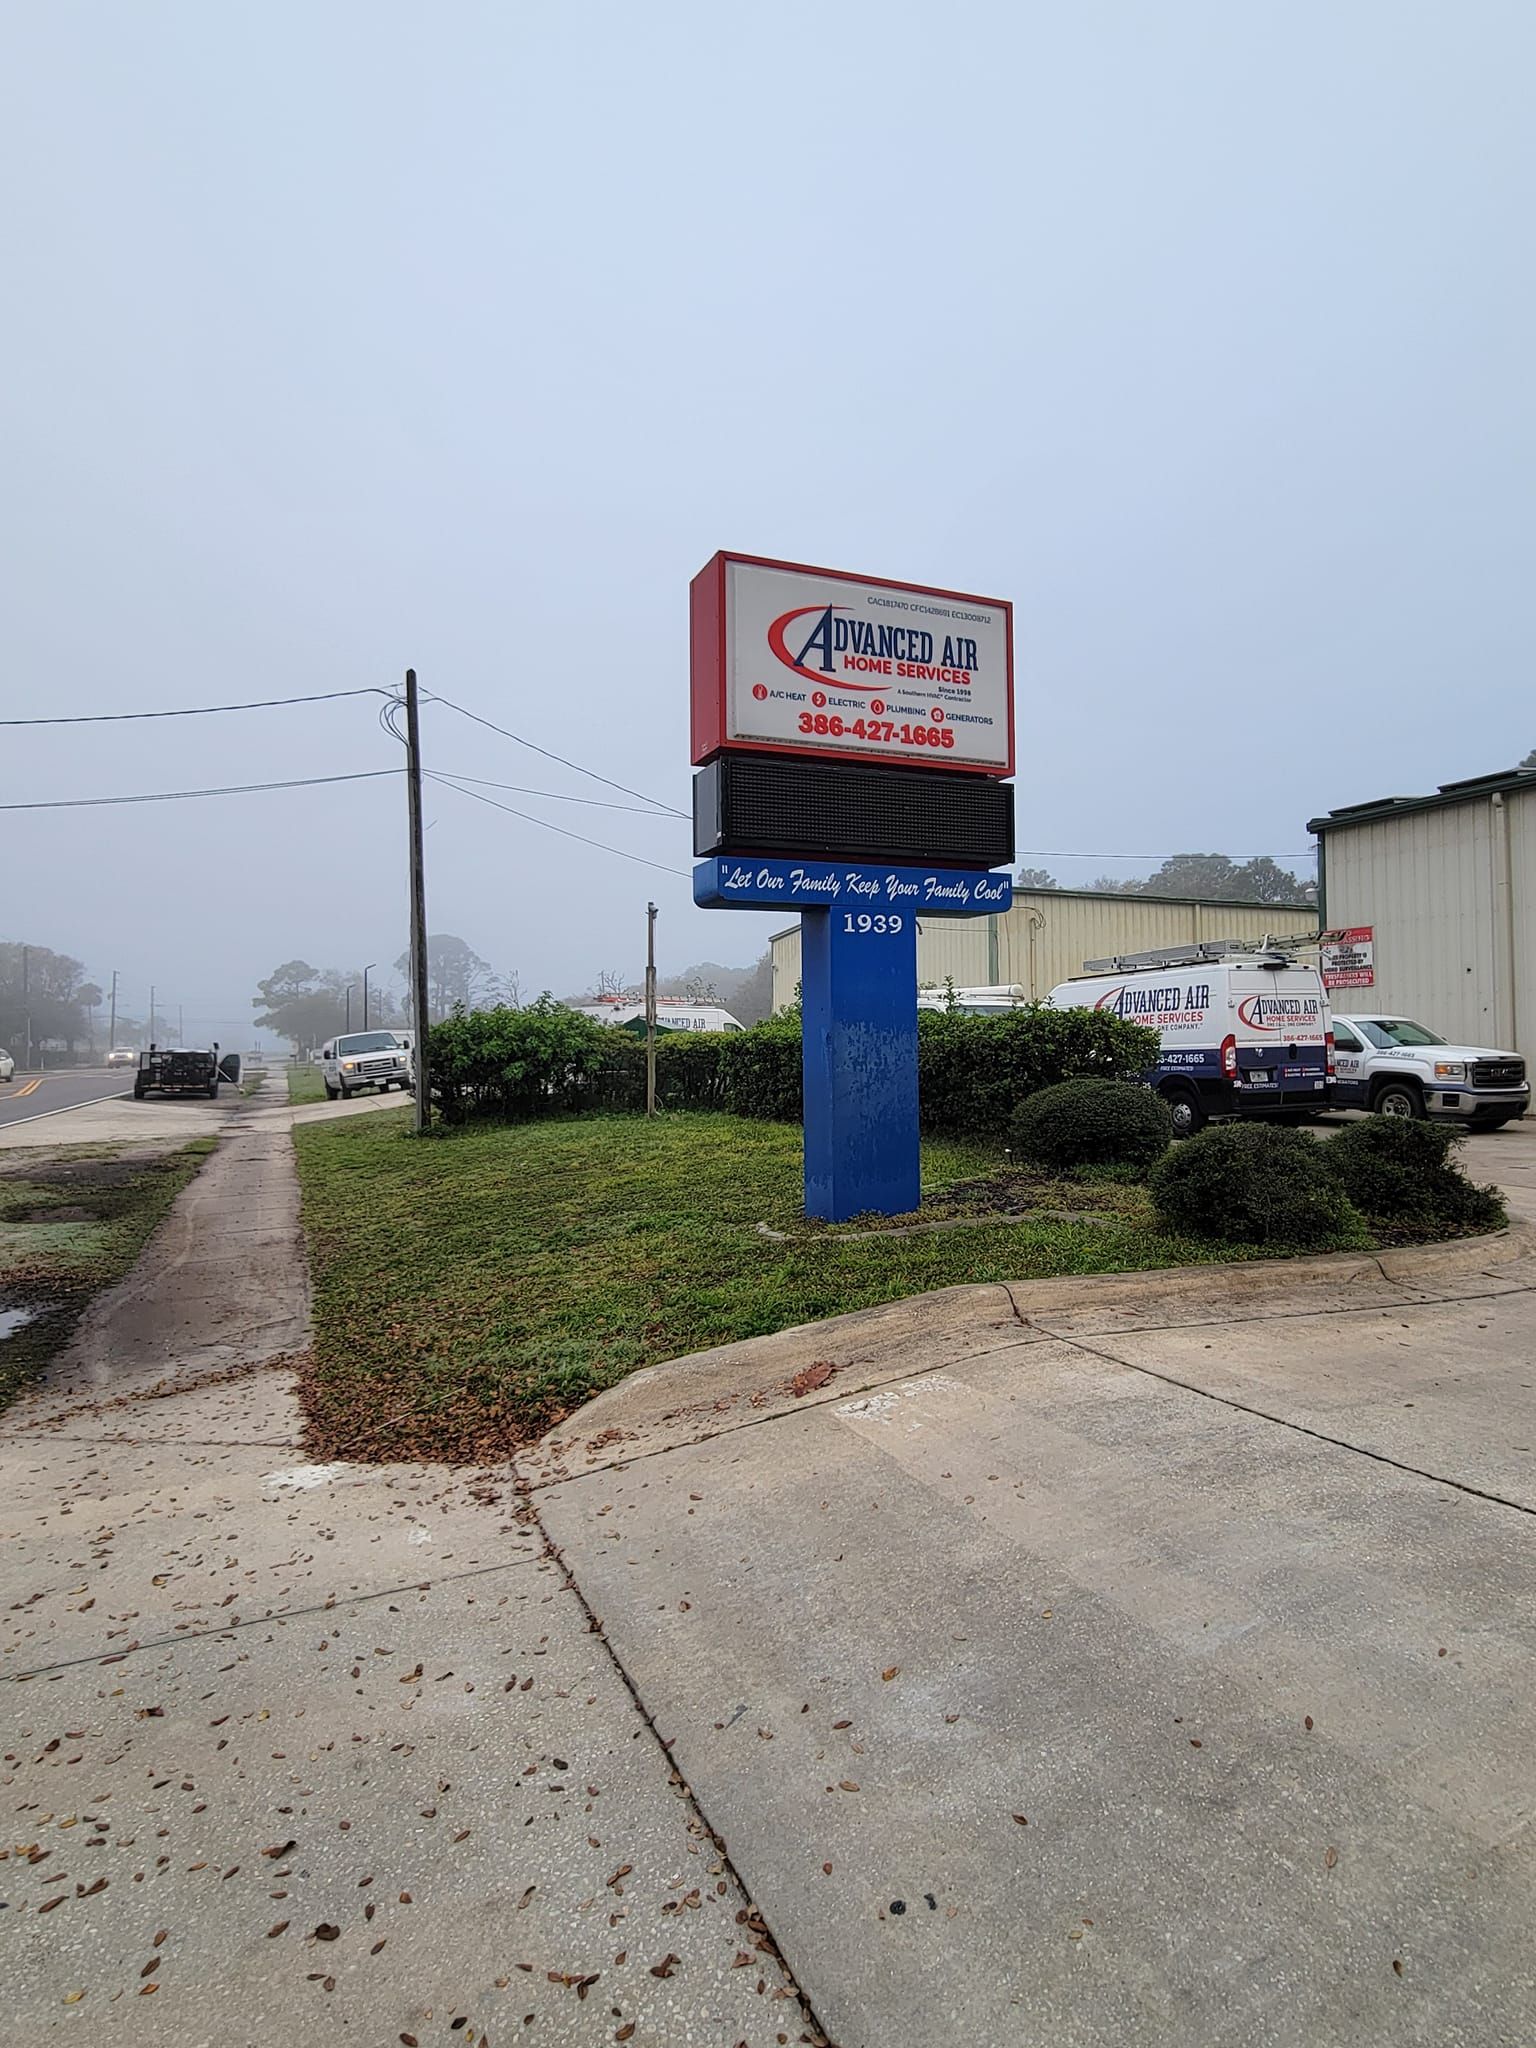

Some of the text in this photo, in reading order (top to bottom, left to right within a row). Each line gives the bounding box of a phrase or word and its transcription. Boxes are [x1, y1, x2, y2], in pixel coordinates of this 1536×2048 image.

[793, 603, 979, 673] ADVANCED AIR
[844, 655, 971, 686] HOME SERVICES
[769, 690, 807, 702] A/C HEAT
[938, 686, 955, 694] Since
[828, 697, 866, 709] ELECTRIC
[886, 704, 927, 717] PLUMBING
[945, 713, 993, 725] GENERATORS
[798, 712, 955, 749] 386-427-1665
[756, 868, 785, 889] Our
[789, 869, 842, 899] Family
[845, 872, 881, 900] Keep
[885, 874, 920, 901] Your
[923, 877, 971, 905] Family
[843, 912, 903, 934] 1939
[1184, 985, 1210, 1010] AIR
[1248, 995, 1319, 1025] ADVANCED AIR
[692, 1018, 706, 1029] AIR
[1157, 1011, 1204, 1024] SERVICES
[1283, 1034, 1323, 1042] 386-427-1665
[1156, 1053, 1205, 1064] 6-427-1665
